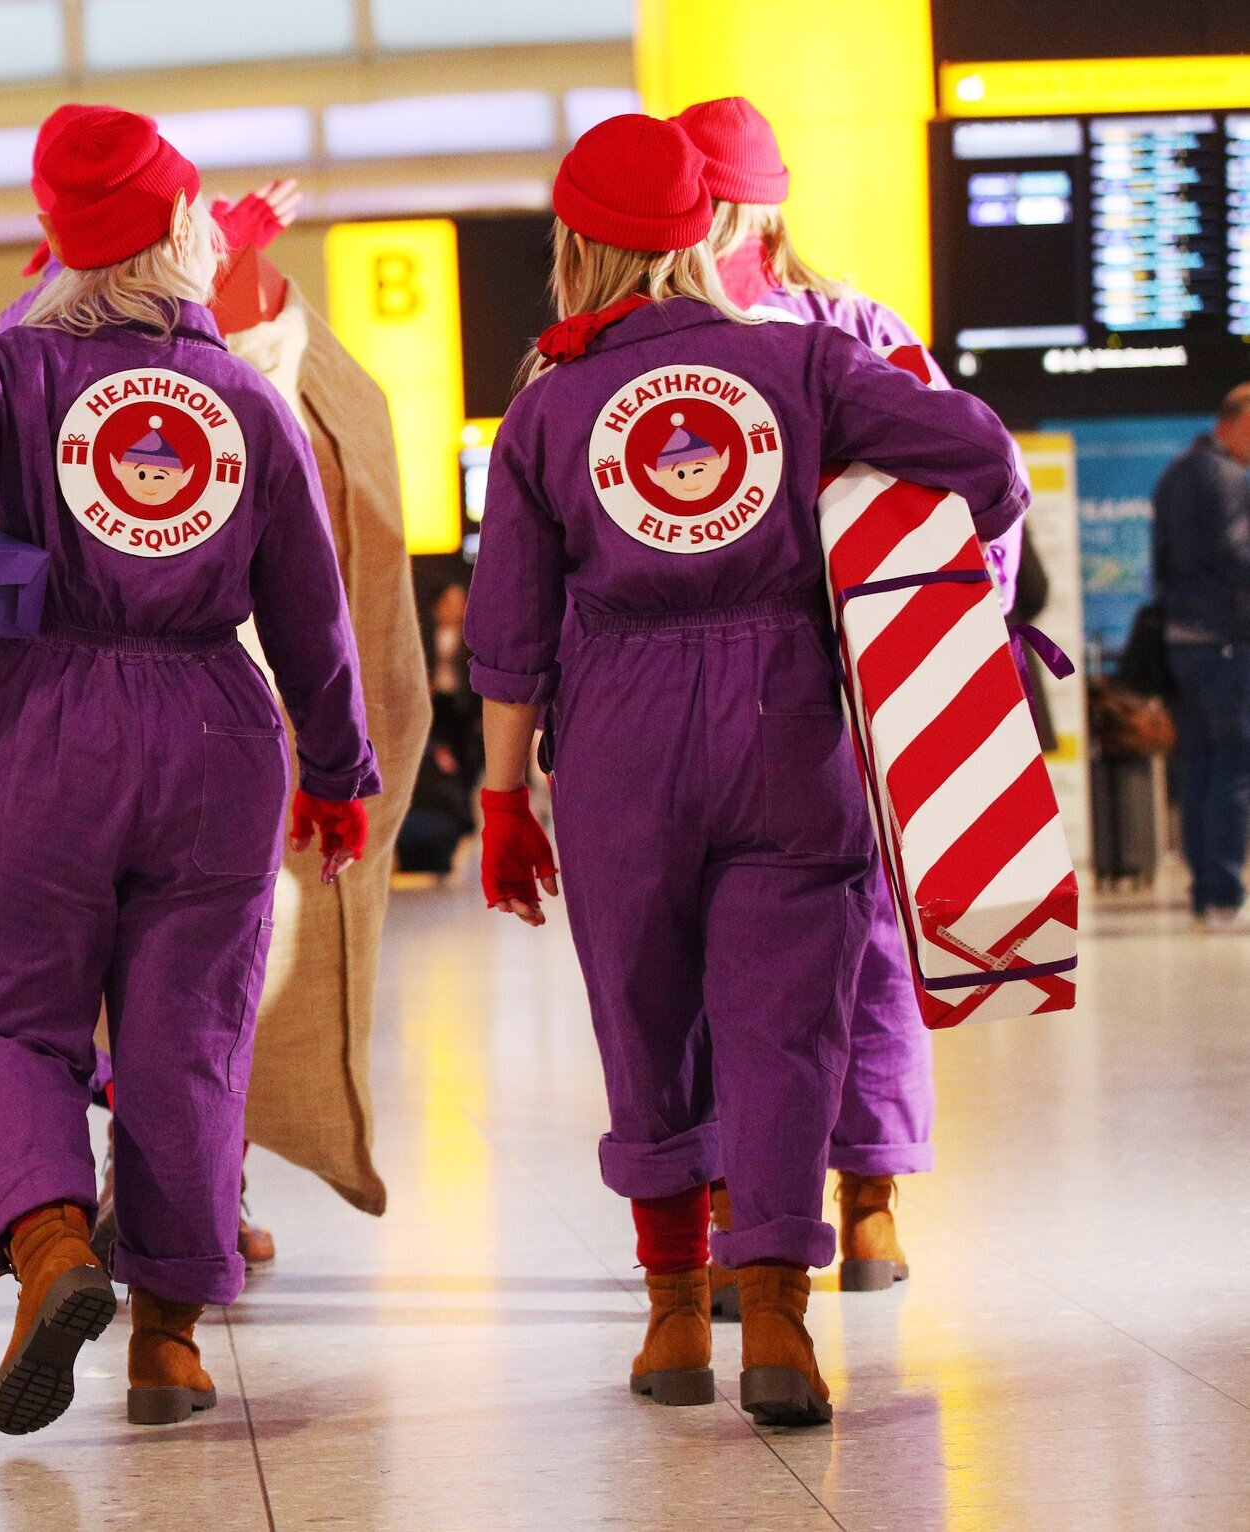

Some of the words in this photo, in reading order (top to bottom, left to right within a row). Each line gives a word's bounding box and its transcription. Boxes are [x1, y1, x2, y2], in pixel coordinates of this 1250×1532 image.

[373, 253, 419, 318] B
[85, 377, 228, 429] HEATHROW
[604, 373, 748, 433] HEATHROW
[83, 500, 126, 537] ELF
[128, 509, 213, 552] SQUAD
[637, 513, 683, 544] ELF
[689, 485, 765, 545] SQUAD
